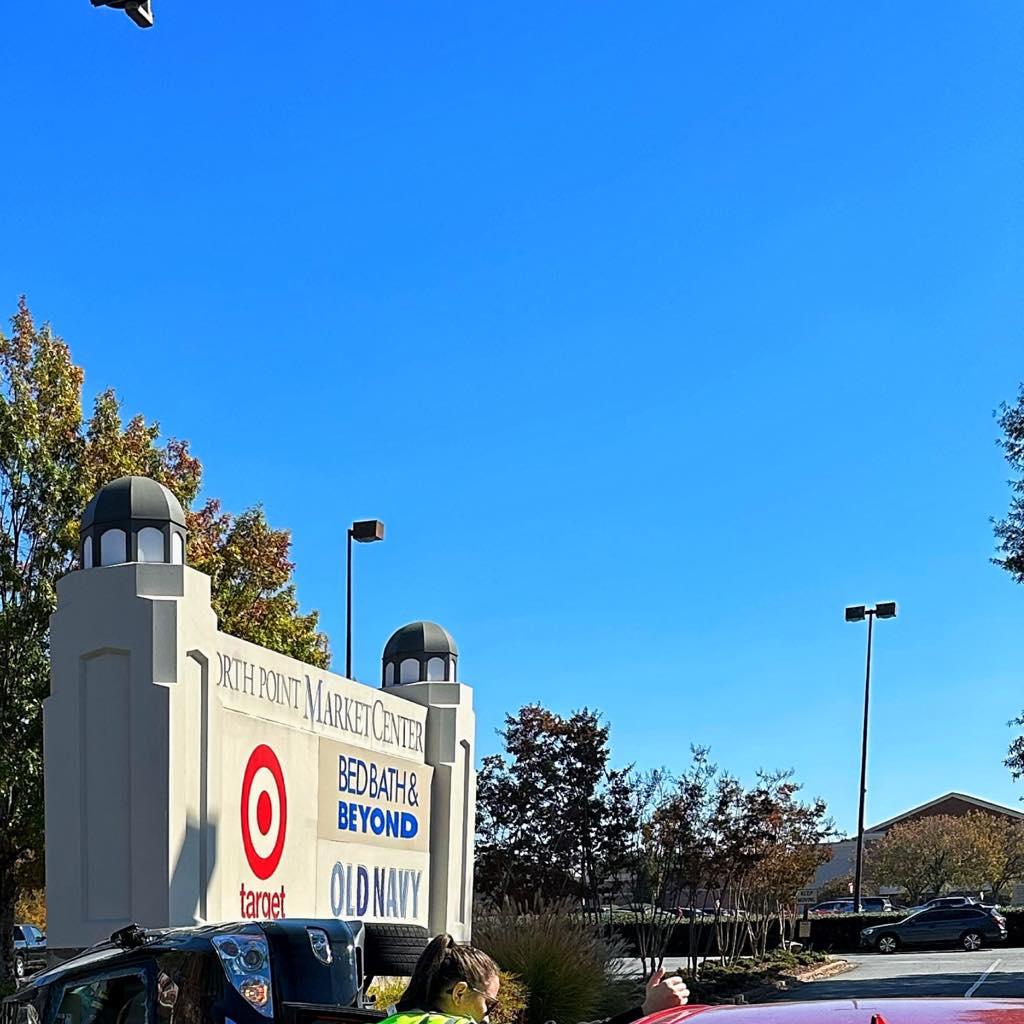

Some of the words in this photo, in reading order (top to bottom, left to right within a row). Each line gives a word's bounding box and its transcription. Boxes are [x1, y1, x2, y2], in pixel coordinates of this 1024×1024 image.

[259, 666, 301, 709] POINT
[338, 755, 368, 796] BED
[369, 763, 406, 804] BATH
[408, 772, 419, 807] &
[337, 800, 419, 839] BEYOND
[240, 883, 285, 919] target
[330, 860, 369, 917] OLD
[373, 866, 422, 919] NAVY
